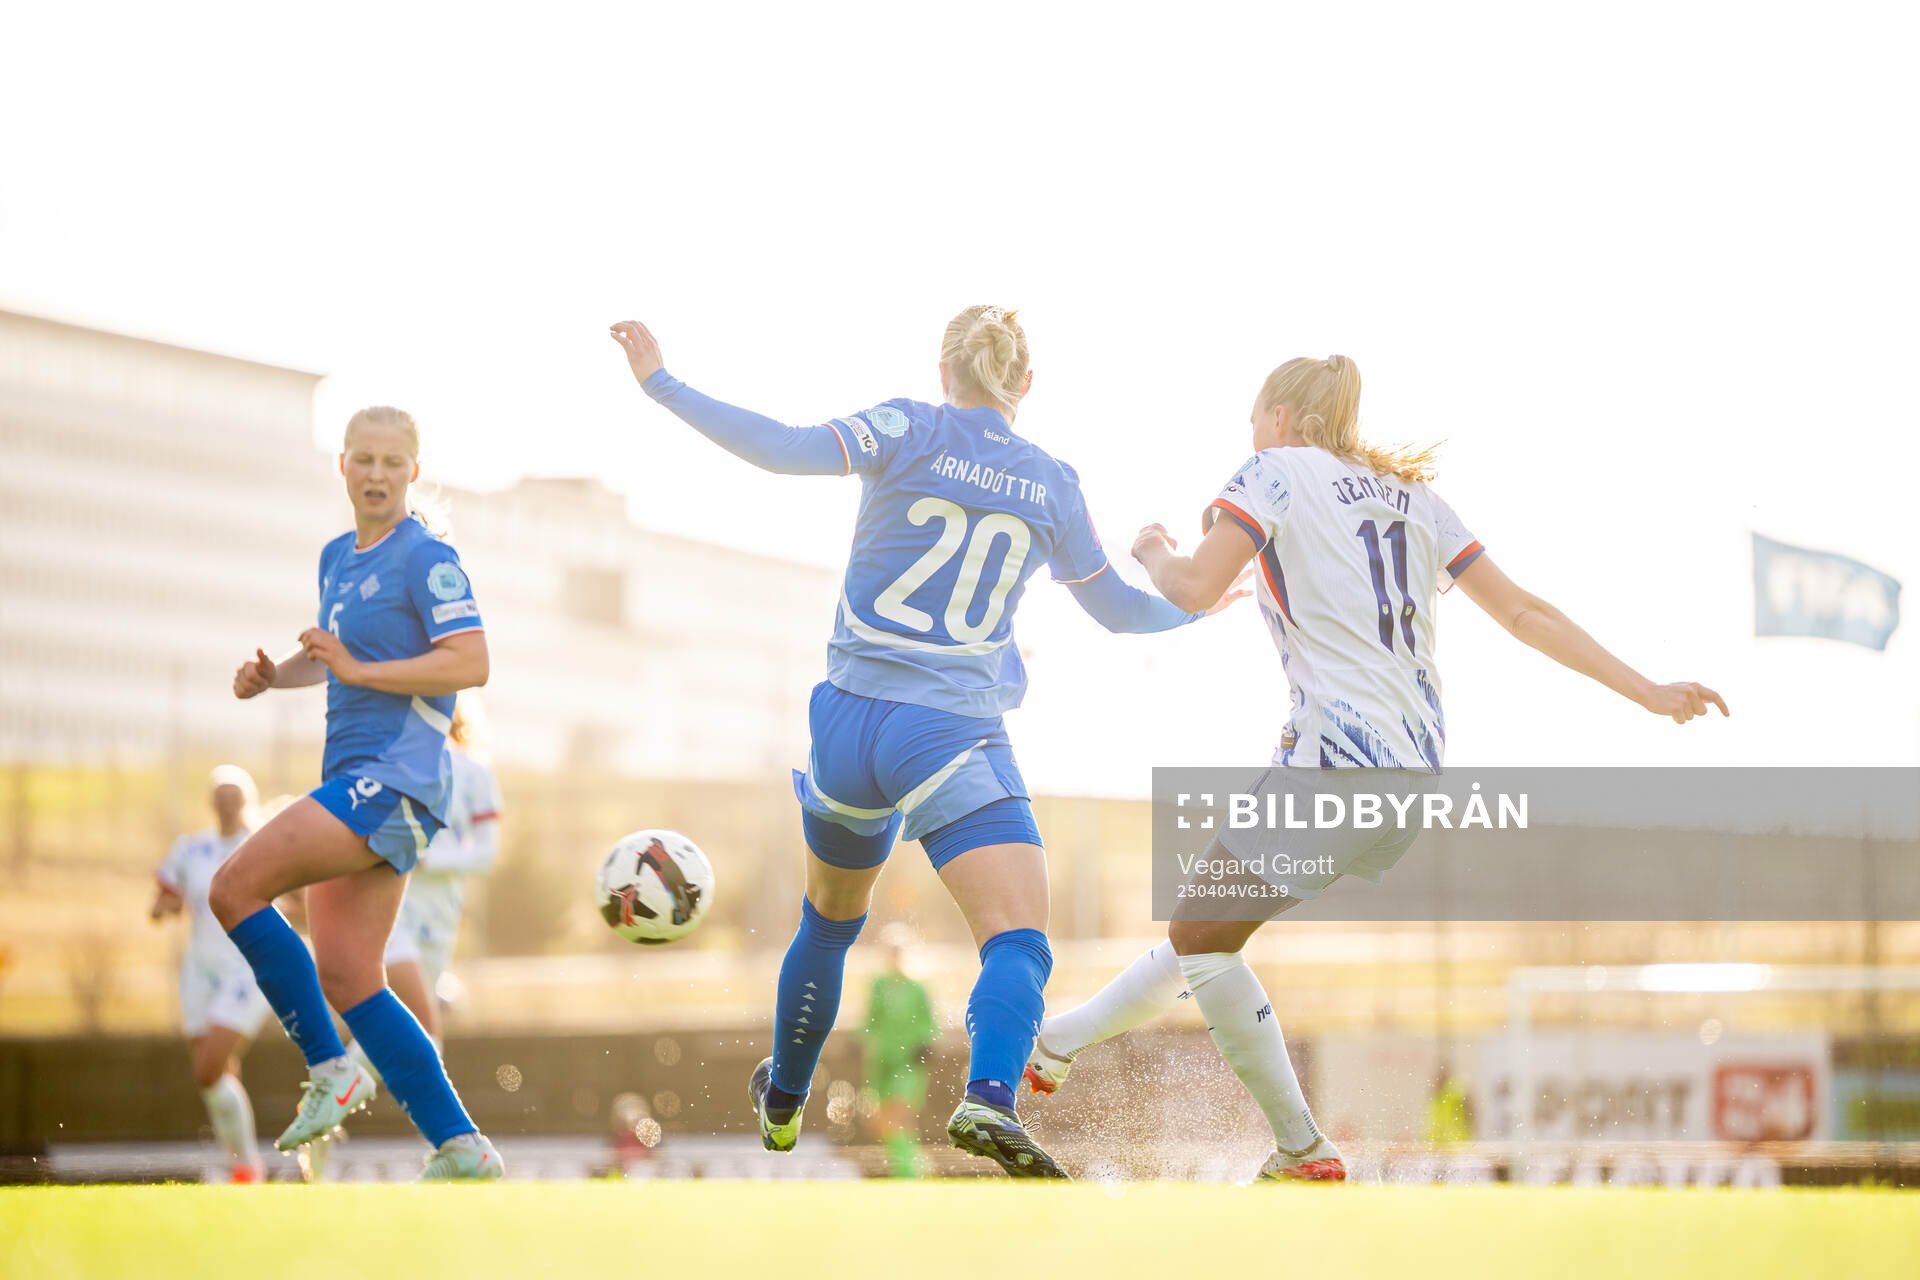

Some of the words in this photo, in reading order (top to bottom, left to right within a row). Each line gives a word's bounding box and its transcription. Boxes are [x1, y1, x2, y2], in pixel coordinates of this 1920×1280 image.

[930, 449, 1047, 506] ÁRNADÓTTIR
[1331, 476, 1410, 515] JENSEN
[874, 497, 1031, 643] 20
[1356, 520, 1416, 658] 11
